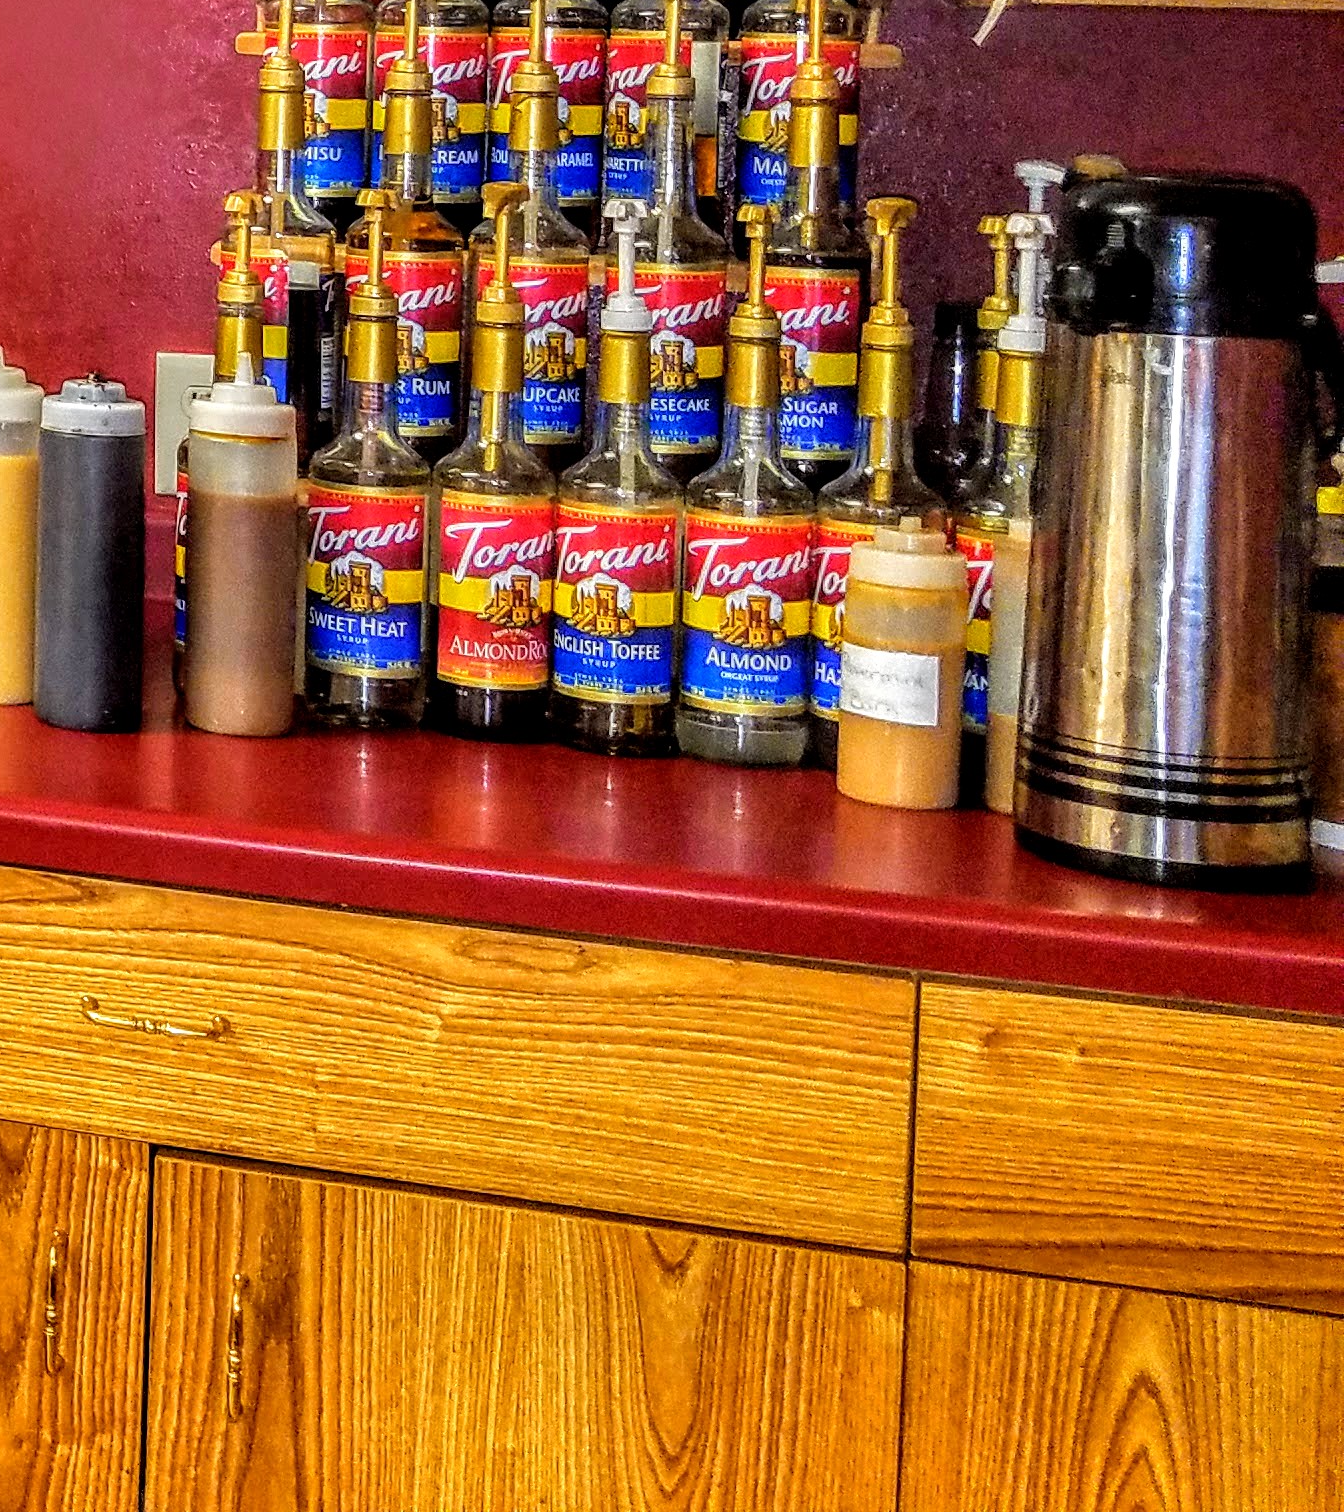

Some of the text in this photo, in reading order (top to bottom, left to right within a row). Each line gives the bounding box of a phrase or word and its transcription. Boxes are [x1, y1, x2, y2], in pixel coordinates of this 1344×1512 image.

[308, 505, 421, 566] Torani
[445, 518, 556, 583] Toran
[554, 525, 668, 590] Torani
[688, 532, 812, 602] Torani
